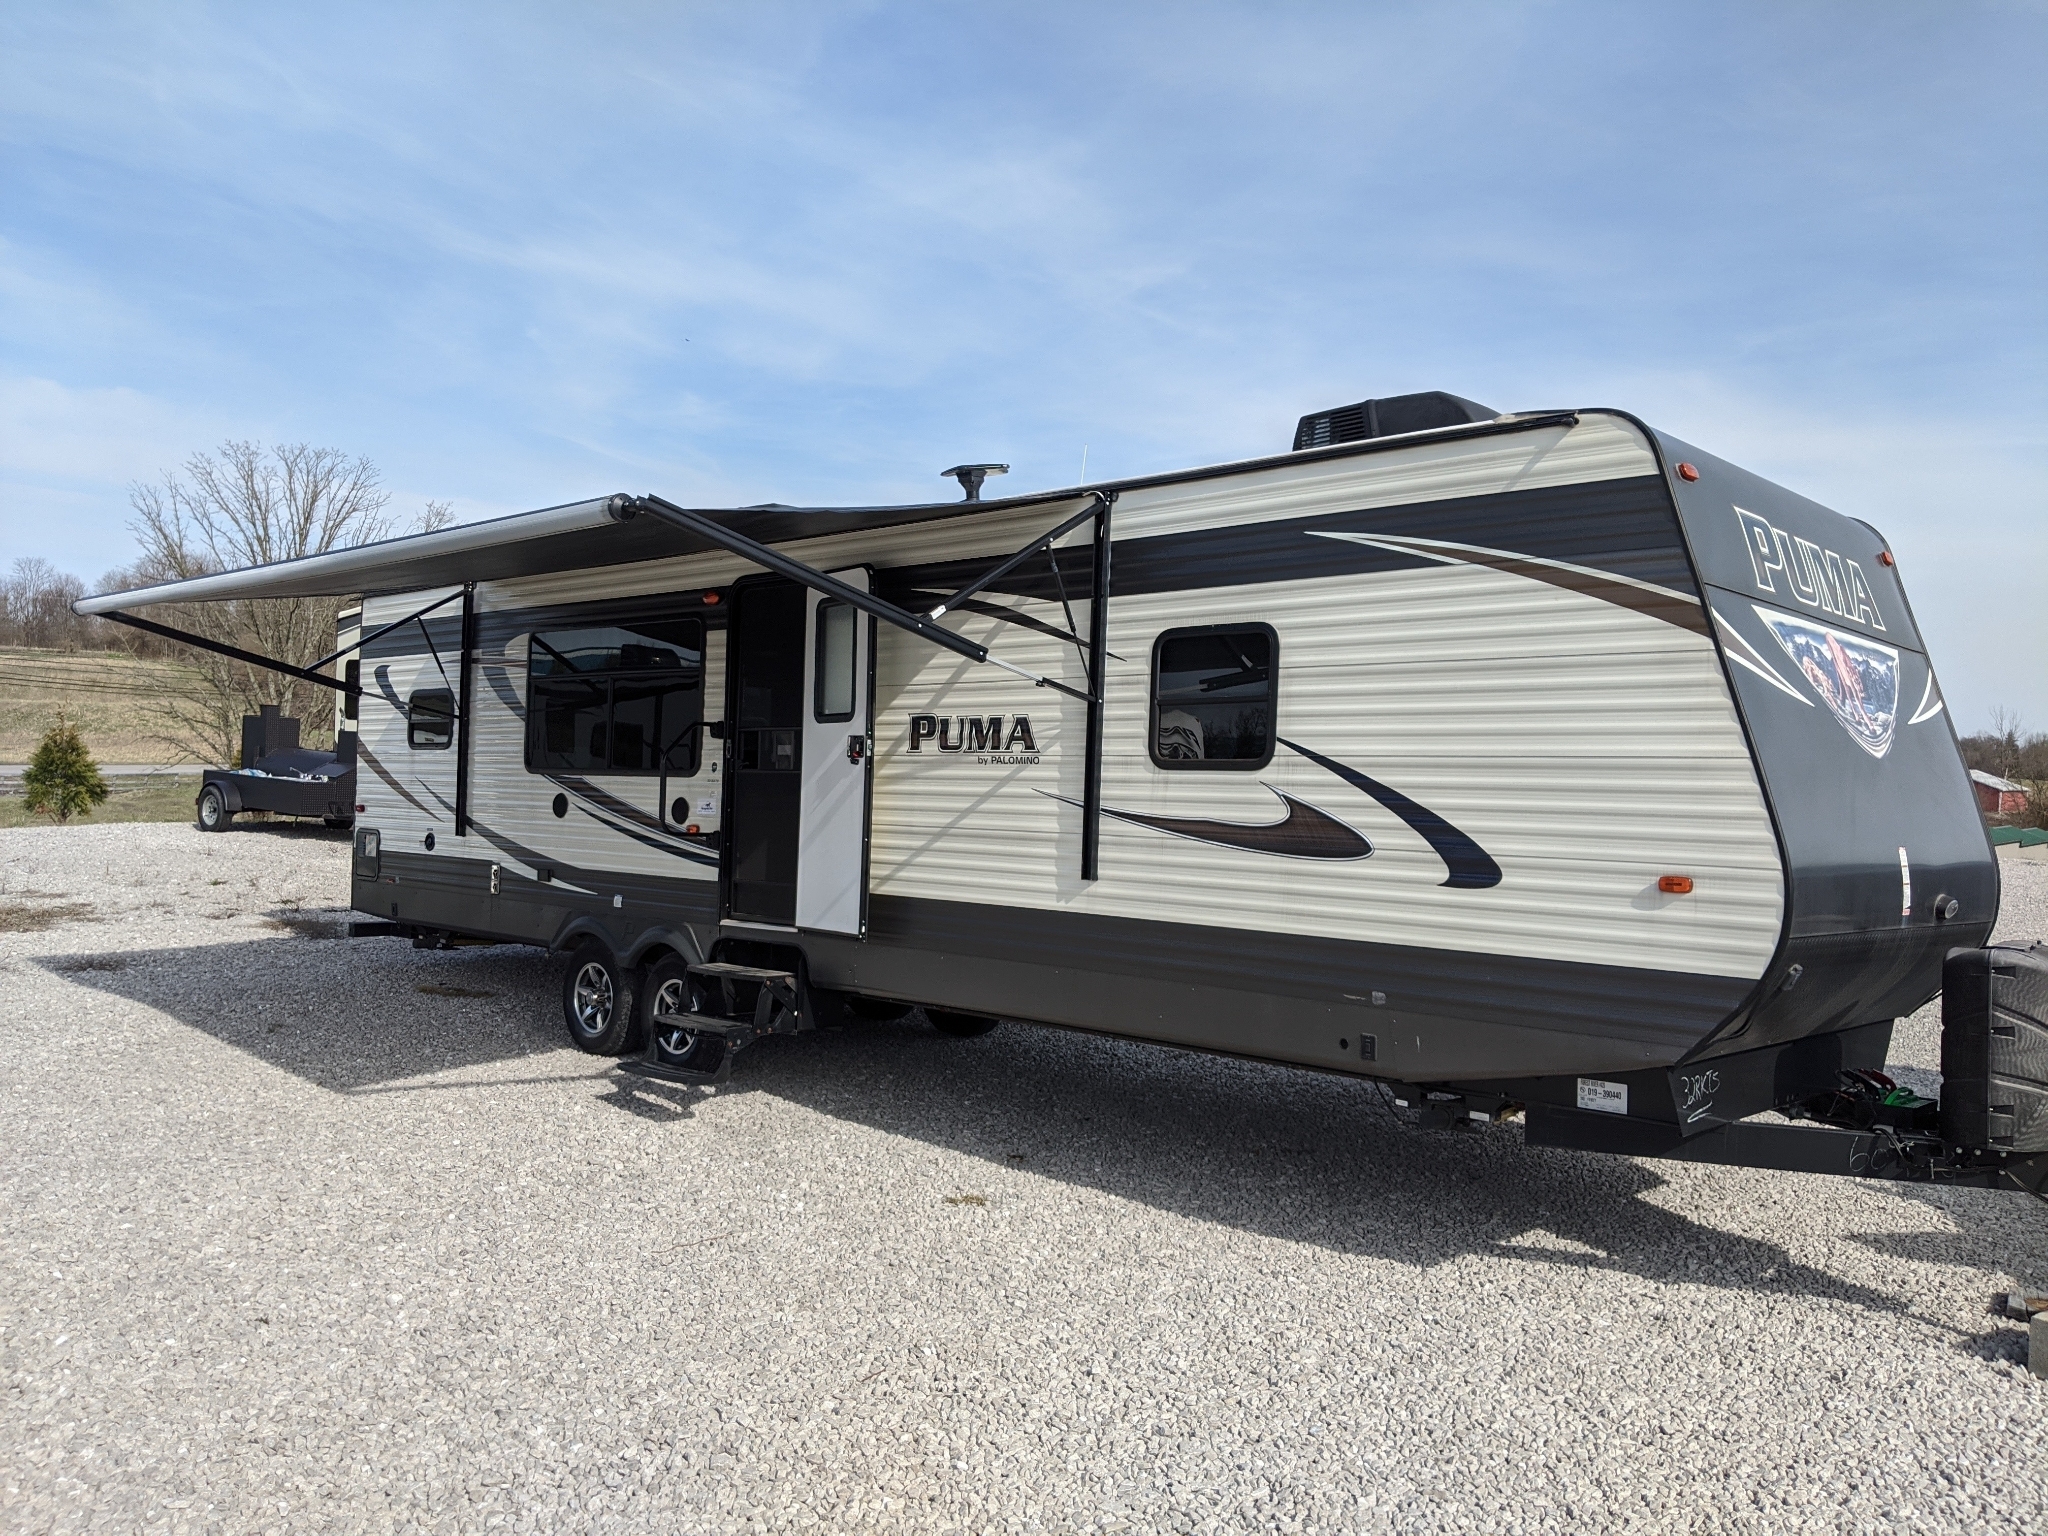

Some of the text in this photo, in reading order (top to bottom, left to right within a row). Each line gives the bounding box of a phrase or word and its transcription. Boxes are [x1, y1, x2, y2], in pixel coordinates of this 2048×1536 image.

[1733, 505, 1887, 631] PUMA
[907, 713, 1040, 754] PUMA
[977, 756, 1040, 766] by PALOMINO
